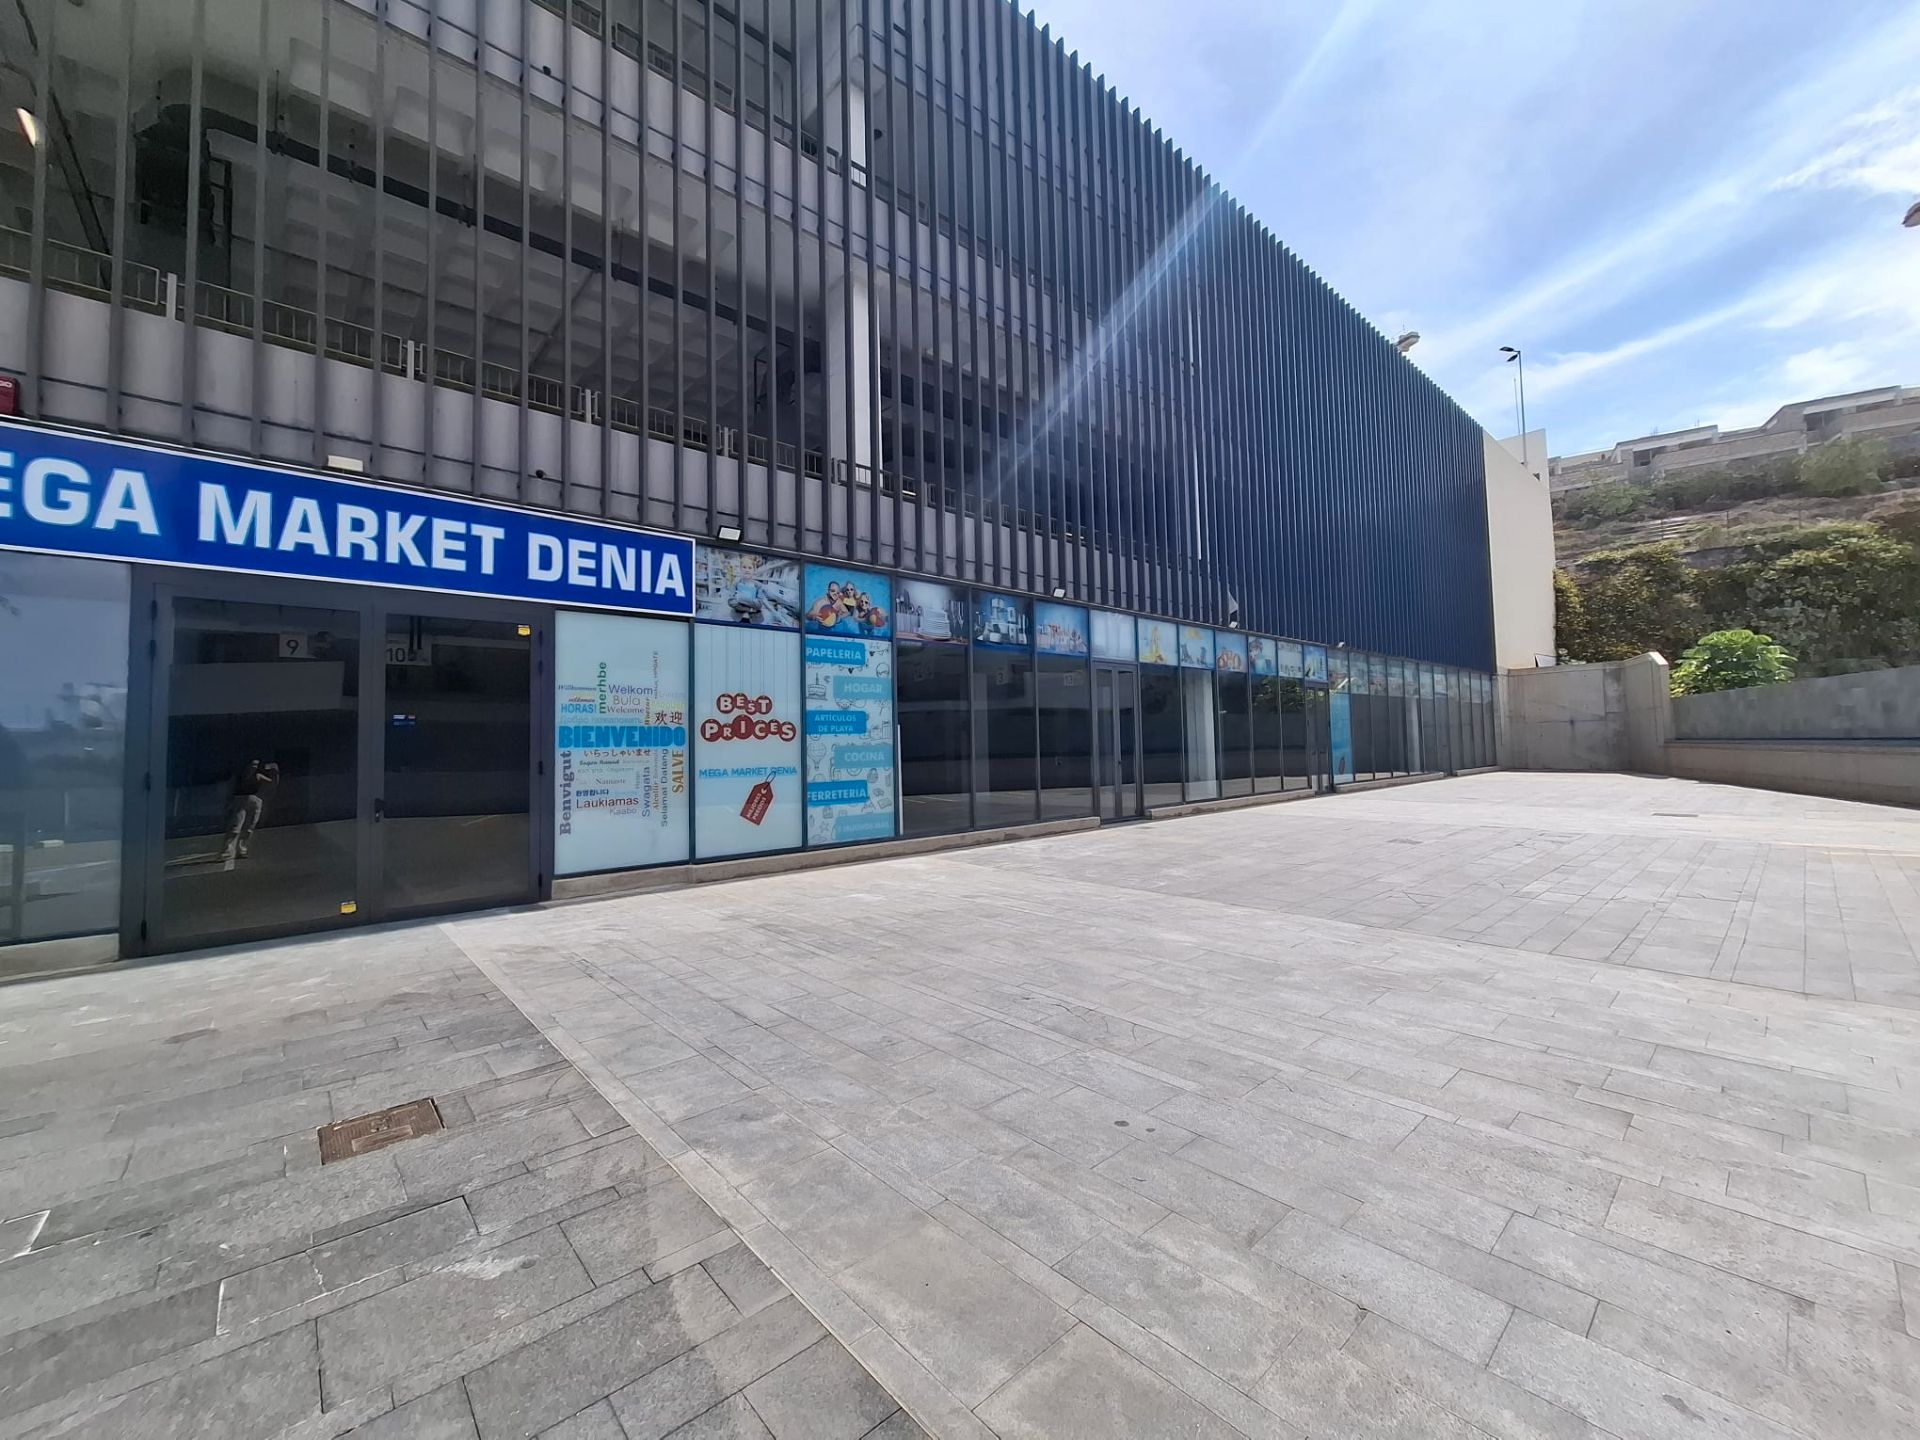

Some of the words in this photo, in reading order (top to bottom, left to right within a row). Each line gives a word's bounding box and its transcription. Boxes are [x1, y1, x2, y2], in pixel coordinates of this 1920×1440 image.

[198, 481, 505, 575] MARKET
[527, 531, 686, 598] DENIA
[286, 639, 299, 655] 9
[386, 647, 406, 663] 10
[597, 662, 607, 714] merhbe
[609, 684, 653, 696] Welkom
[843, 682, 883, 694] HOGAR
[613, 695, 641, 706] Bula
[719, 695, 770, 713] BEST
[607, 706, 645, 714] Welcome
[655, 709, 684, 725] 欢迎
[559, 725, 685, 748] BIENVENIDO
[704, 720, 795, 740] PRICES
[831, 725, 854, 733] PLAYA
[845, 751, 885, 761] COCINA
[661, 749, 669, 784] Datang
[672, 749, 684, 795] SALVE
[700, 768, 729, 778] MEGA
[731, 766, 768, 777] MARKET
[642, 766, 652, 818] Swagata
[577, 797, 639, 809] Laukiamas
